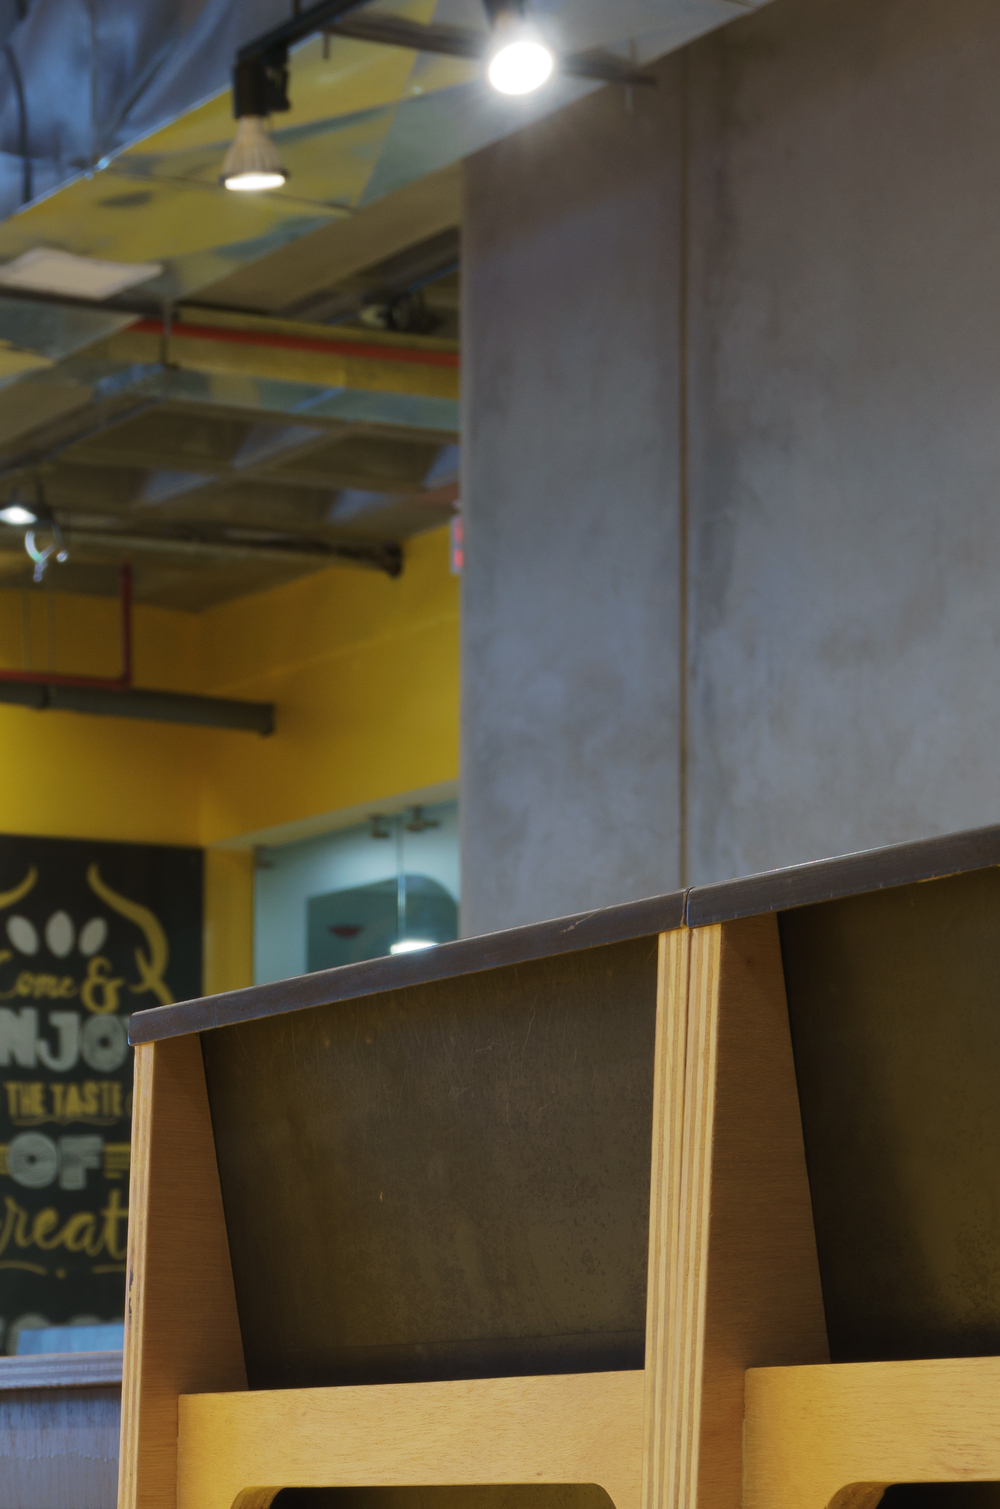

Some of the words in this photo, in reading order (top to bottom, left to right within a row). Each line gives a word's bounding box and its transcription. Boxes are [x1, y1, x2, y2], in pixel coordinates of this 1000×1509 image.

[80, 955, 126, 1015] &
[3, 1079, 46, 1118] THE
[51, 1078, 123, 1118] TASTE
[6, 1131, 103, 1190] OF
